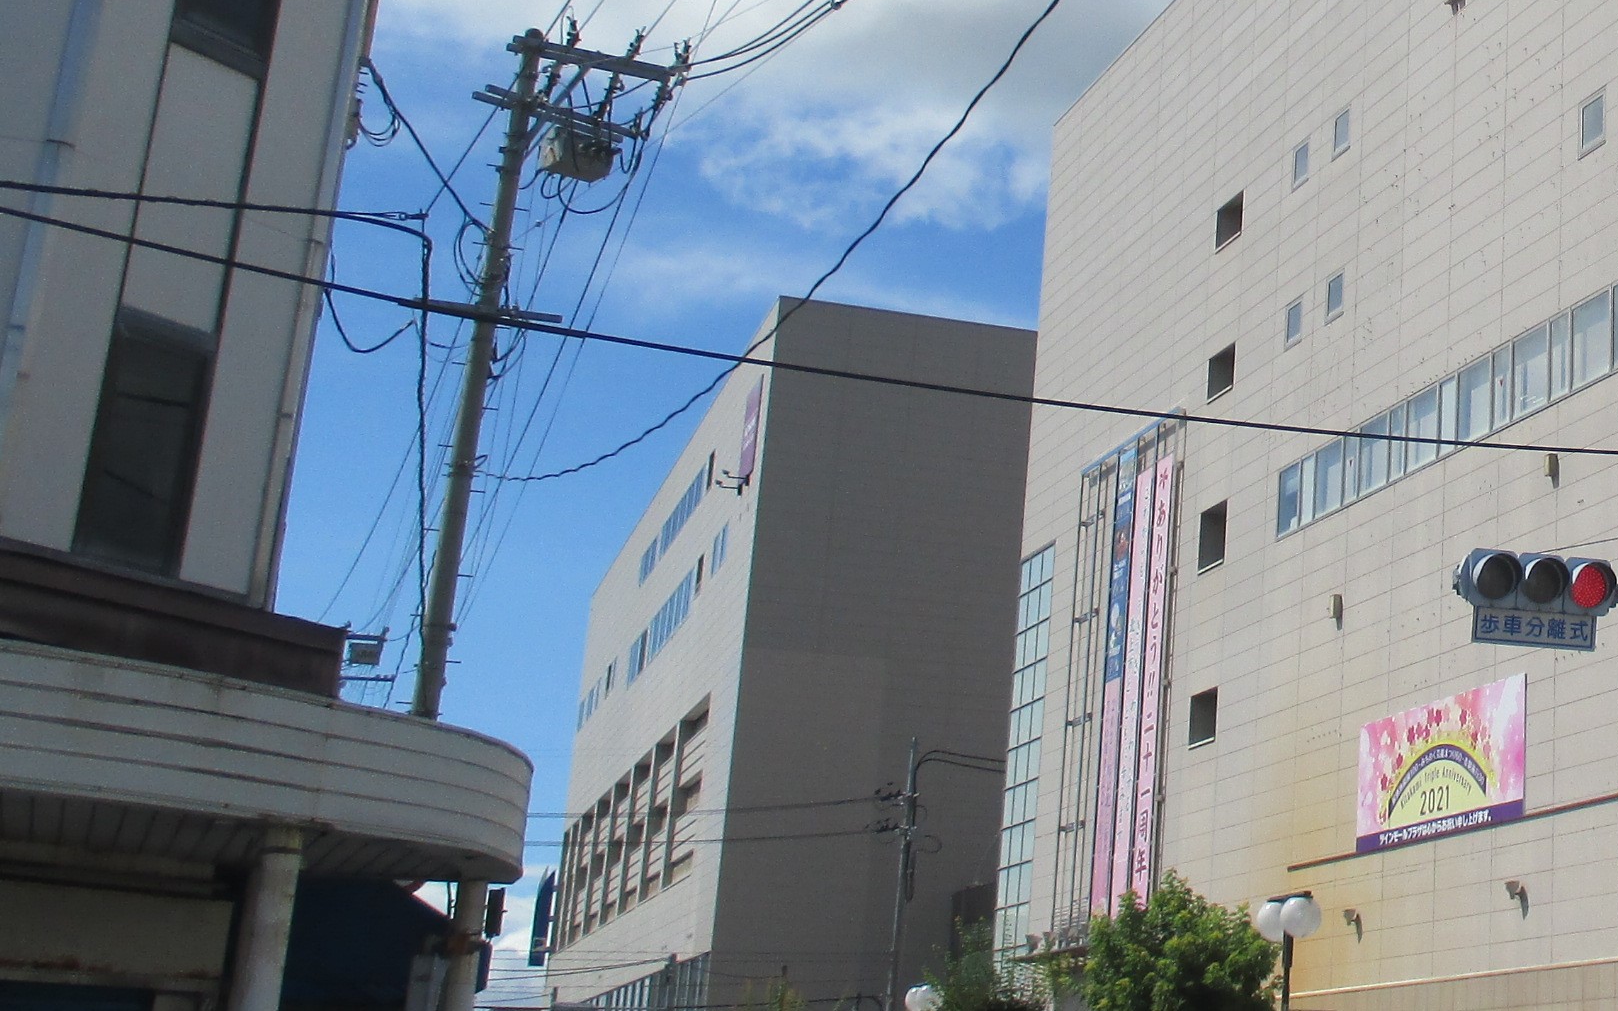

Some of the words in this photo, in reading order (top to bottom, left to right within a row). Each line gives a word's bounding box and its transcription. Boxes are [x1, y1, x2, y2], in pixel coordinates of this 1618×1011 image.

[1480, 613, 1589, 641] 歩車分離式
[1419, 784, 1451, 816] 2021
